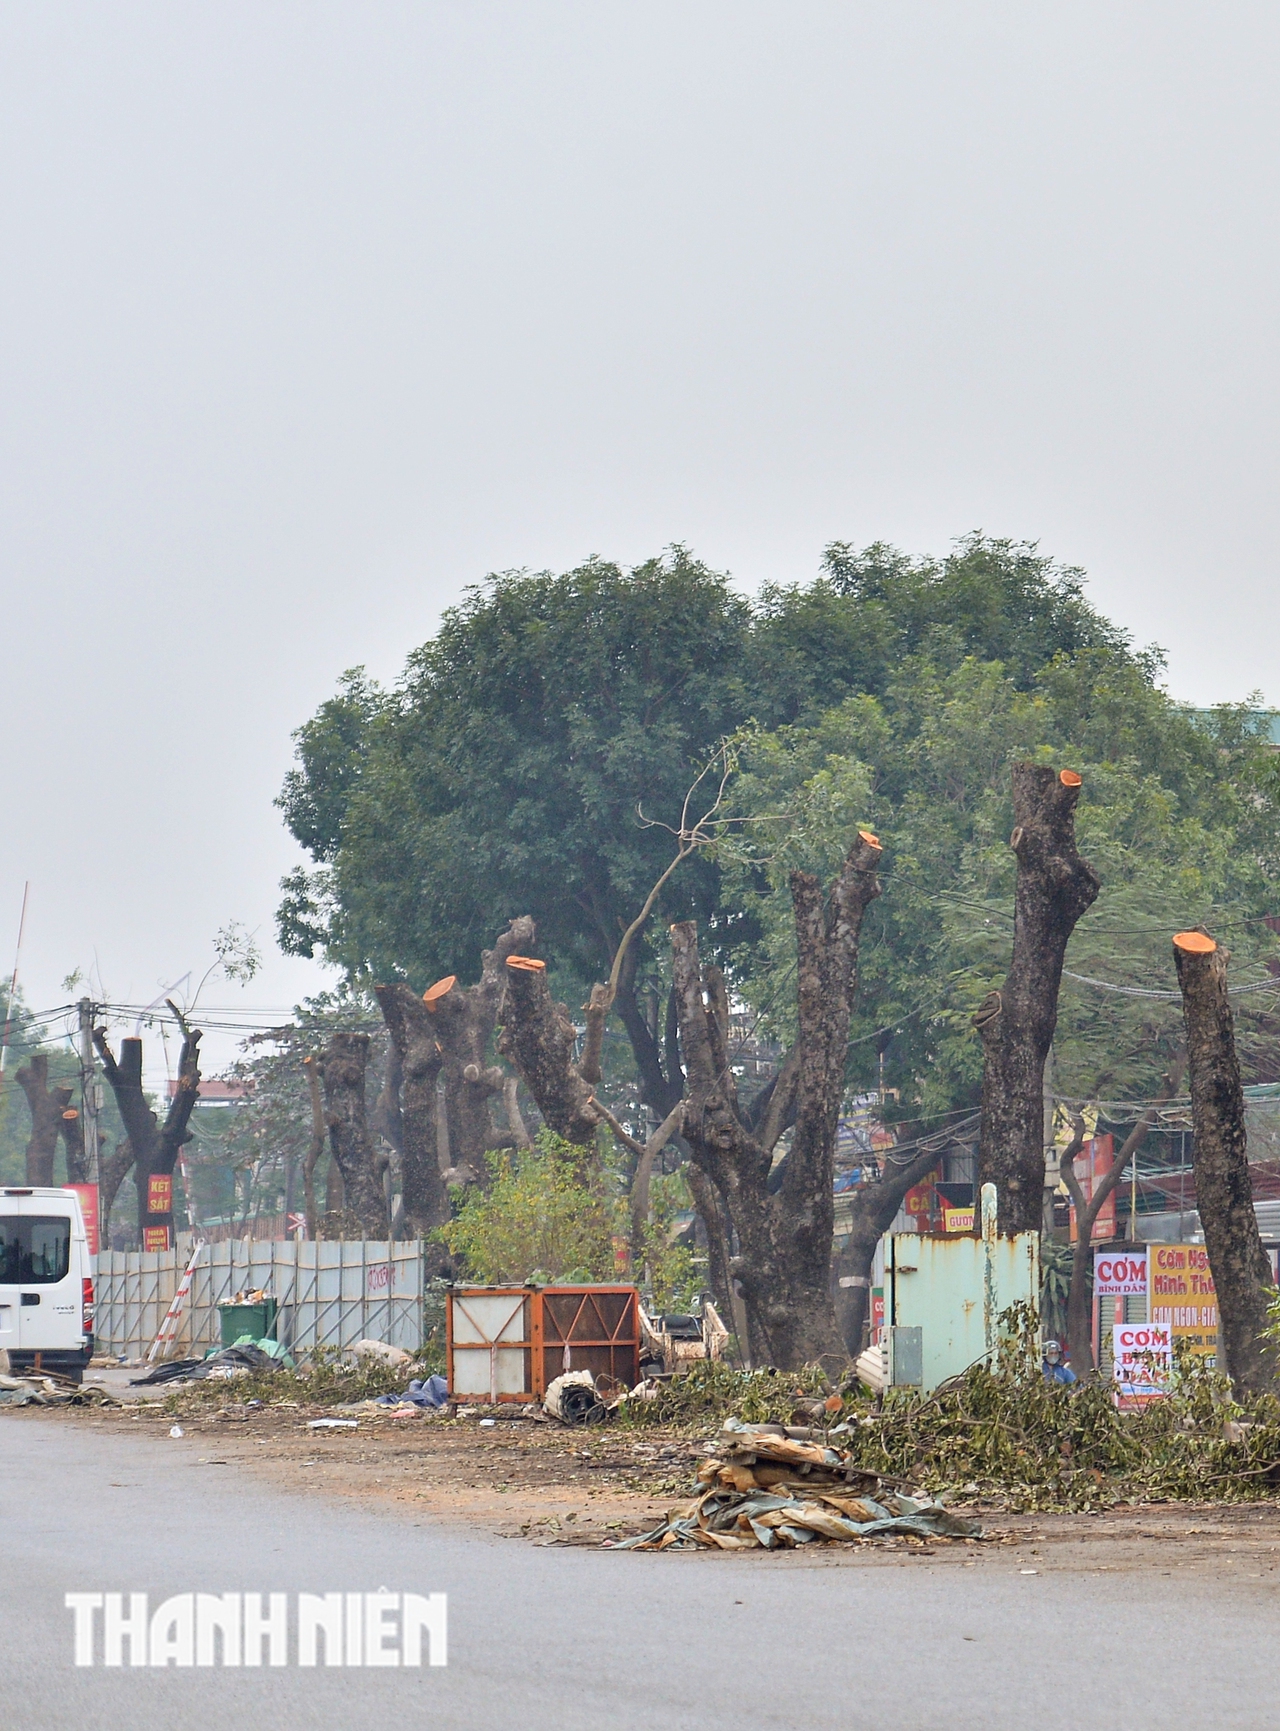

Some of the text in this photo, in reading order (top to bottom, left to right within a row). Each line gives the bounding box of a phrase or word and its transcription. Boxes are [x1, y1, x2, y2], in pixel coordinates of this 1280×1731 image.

[1097, 1257, 1147, 1283] CƠM
[1098, 1284, 1147, 1293] BÌNH DÂN
[1120, 1328, 1169, 1347] CƠM
